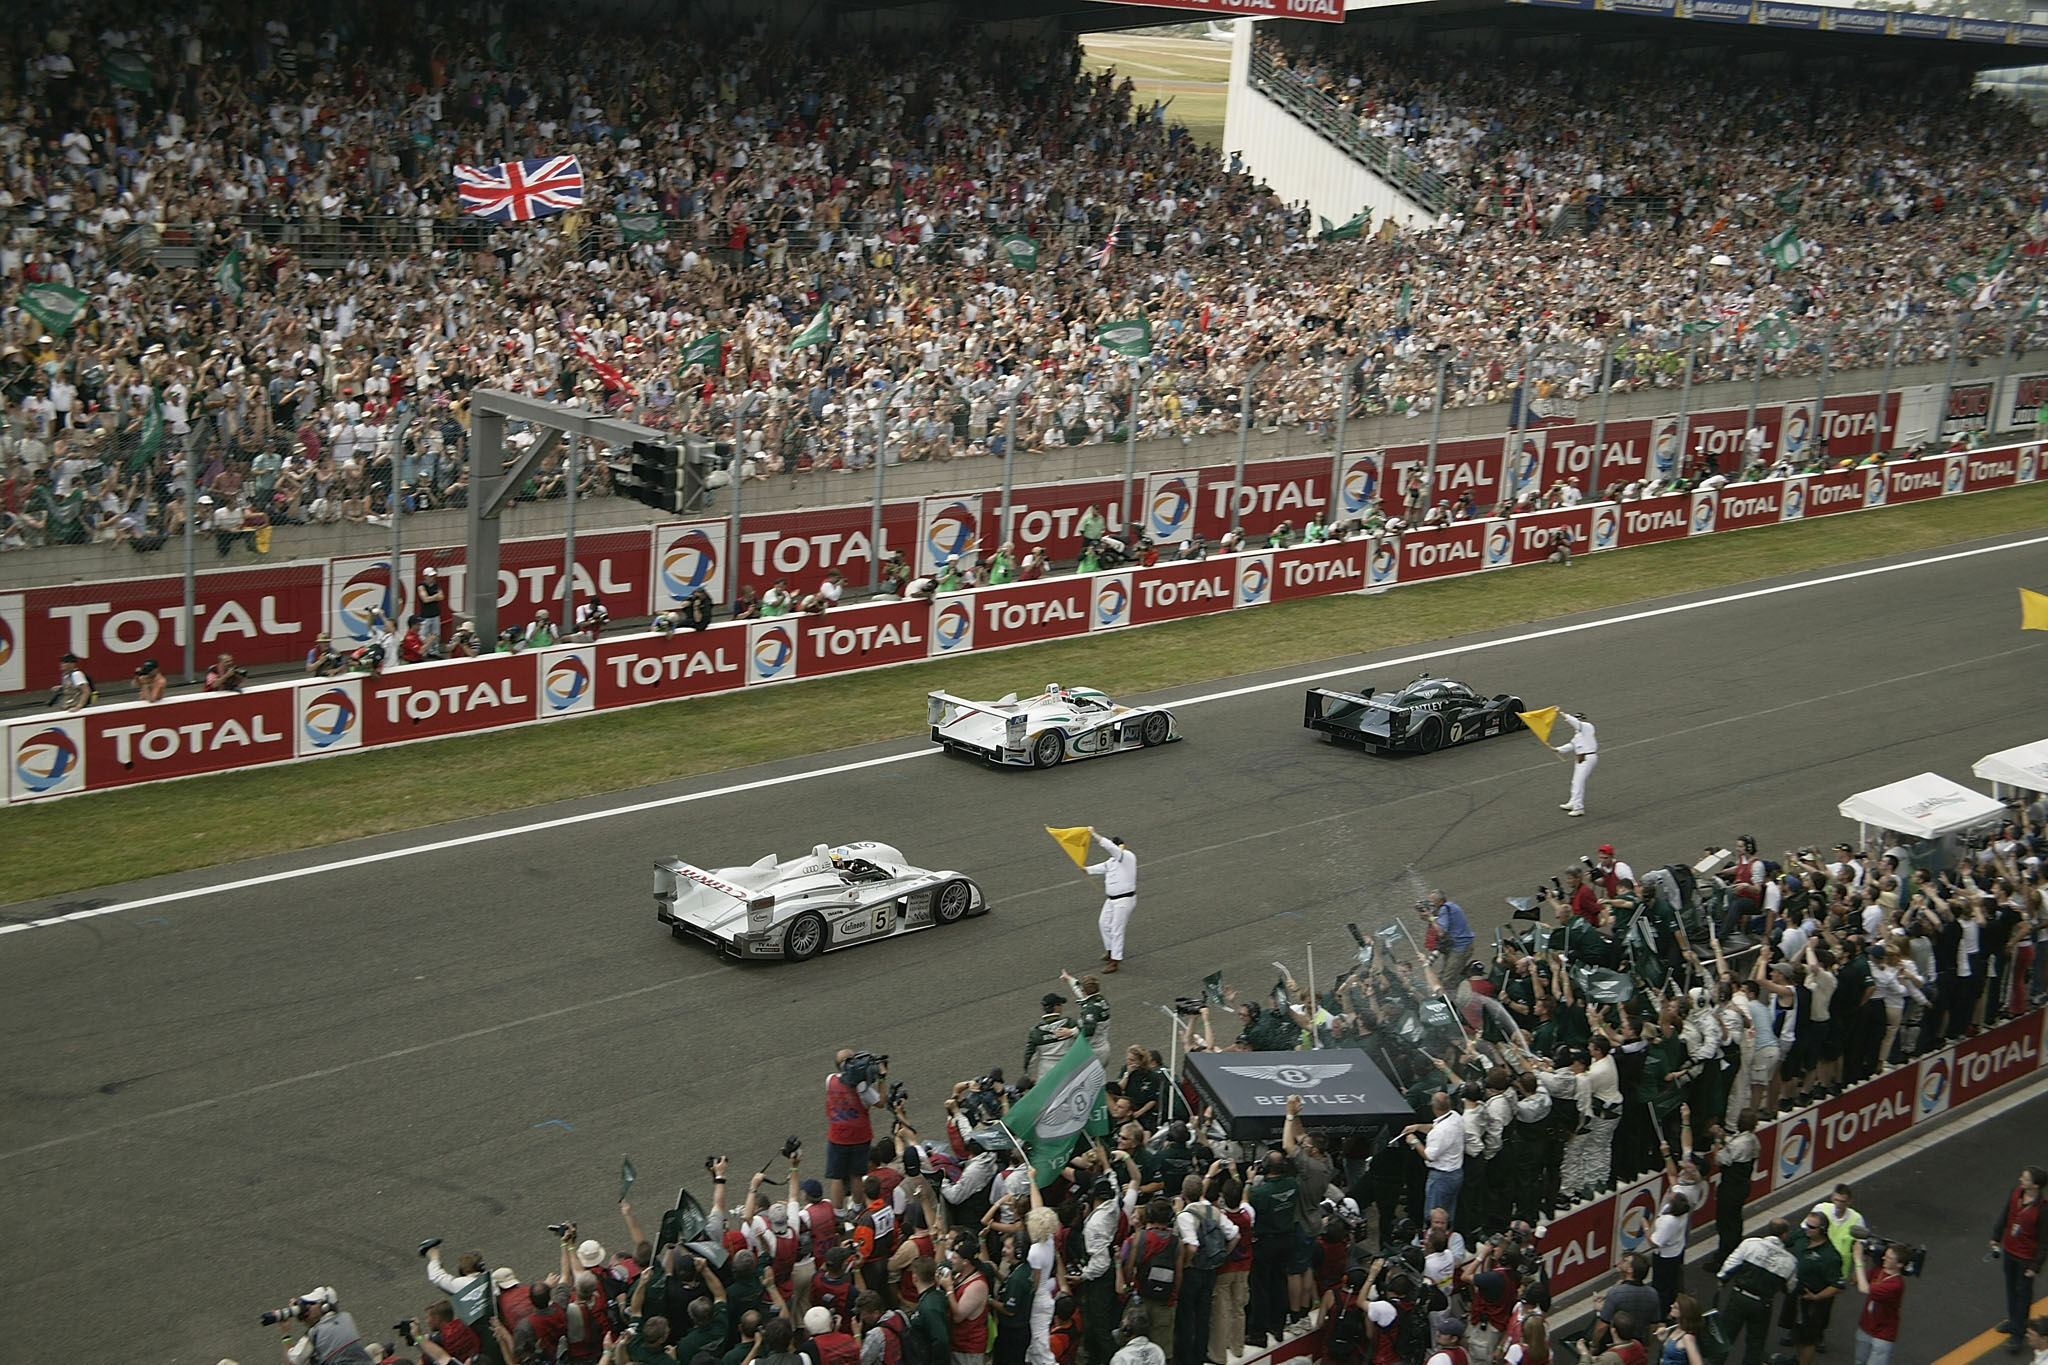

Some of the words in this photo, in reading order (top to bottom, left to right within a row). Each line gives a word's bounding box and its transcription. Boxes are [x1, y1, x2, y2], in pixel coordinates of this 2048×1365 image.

[1286, 0, 1339, 15] TOTAL
[1695, 2, 1749, 16] MICHELIN
[1693, 425, 1774, 456] TOTL
[1391, 460, 1494, 496] TTAL
[1891, 471, 1942, 493] TOTAL
[1208, 479, 1326, 519] TOTAL
[1721, 495, 1779, 520] TOTAL
[1810, 483, 1863, 506] TOTAL
[1624, 508, 1687, 534] TOTAL
[740, 527, 896, 576] TOTAL
[1405, 539, 1480, 567] TOTAL
[1279, 557, 1361, 587] TOTAL
[1139, 576, 1230, 608] TOTAL
[50, 596, 301, 660] TOTAL
[983, 597, 1085, 631] TOTAL
[807, 621, 922, 658] TOTAL
[607, 647, 738, 688] TOTAL
[375, 678, 528, 723] TOTAL
[1409, 701, 1443, 711] ENTLEY
[102, 715, 283, 765] TOTAL
[1100, 731, 1107, 746] 6
[1453, 725, 1460, 740] 7
[875, 910, 887, 930] 5
[1957, 1035, 2037, 1088] TOTAL
[1253, 1094, 1366, 1105] BETLEY
[1820, 1090, 1912, 1149] TOTAL
[1538, 1230, 1607, 1279] TAL
